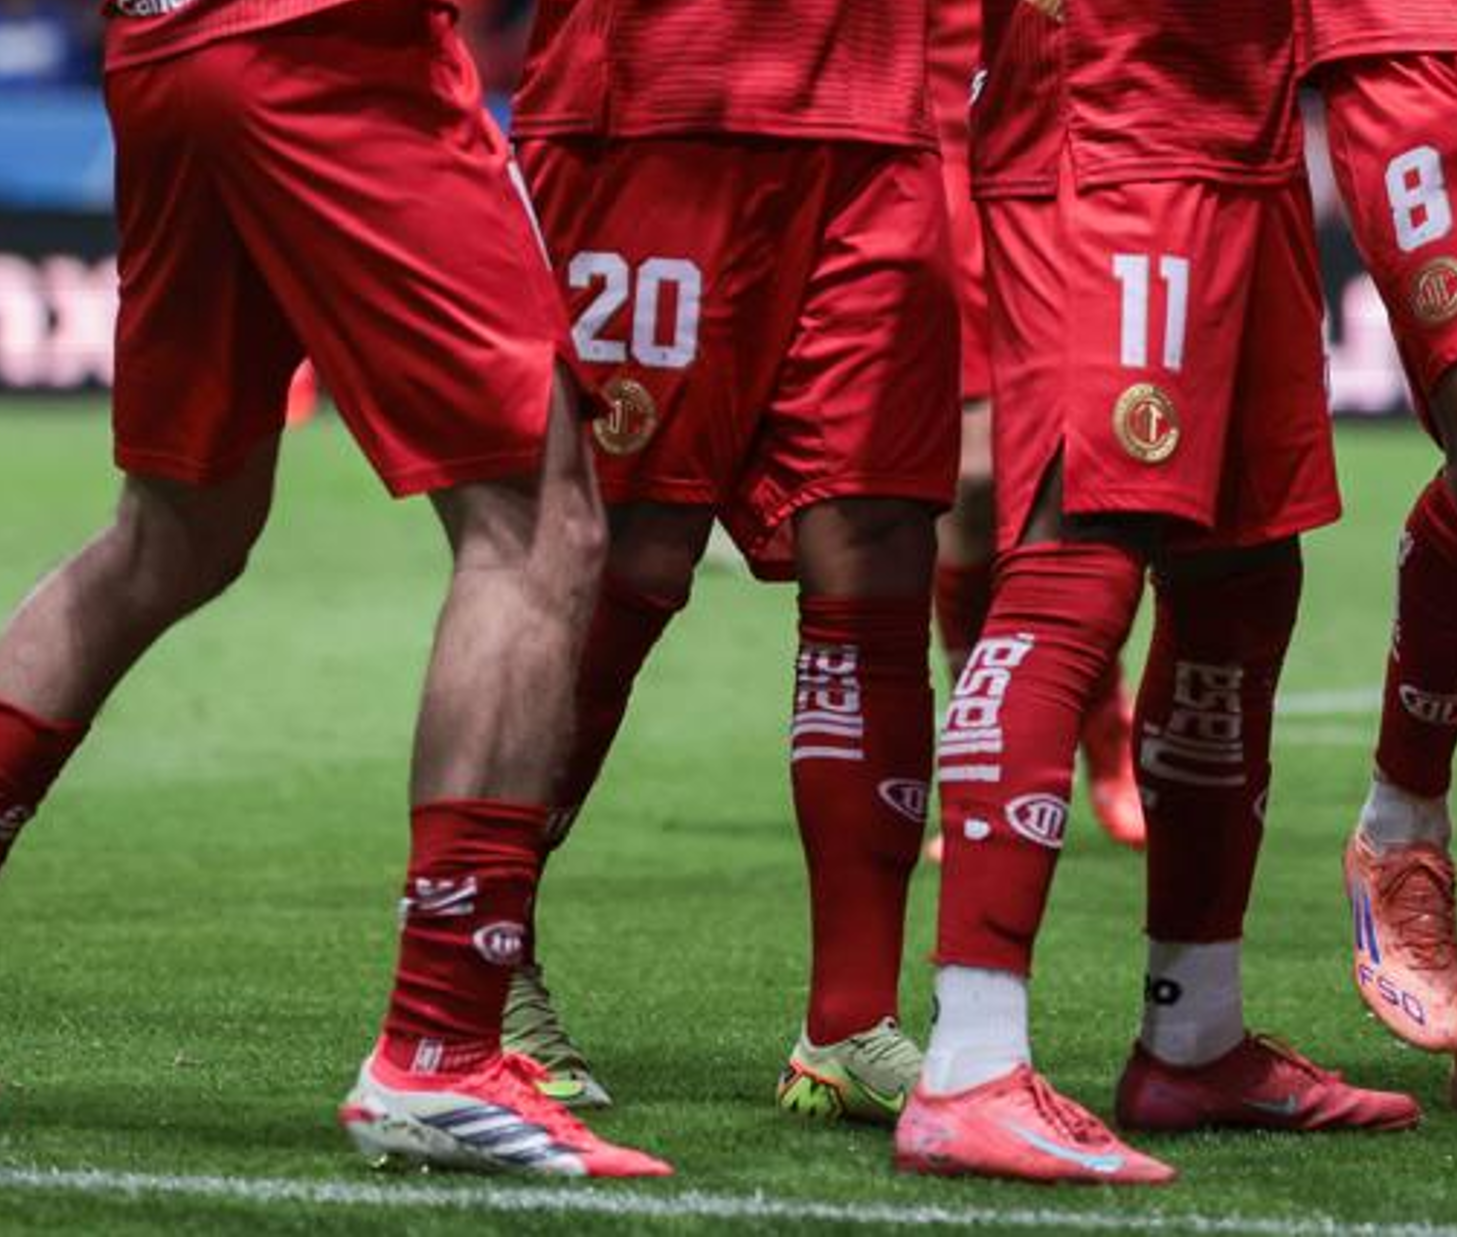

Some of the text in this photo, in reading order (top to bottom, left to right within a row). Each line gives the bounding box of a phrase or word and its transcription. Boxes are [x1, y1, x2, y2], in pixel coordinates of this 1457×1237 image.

[1386, 145, 1453, 253] 8
[568, 250, 703, 368] 20
[1111, 254, 1190, 372] 11
